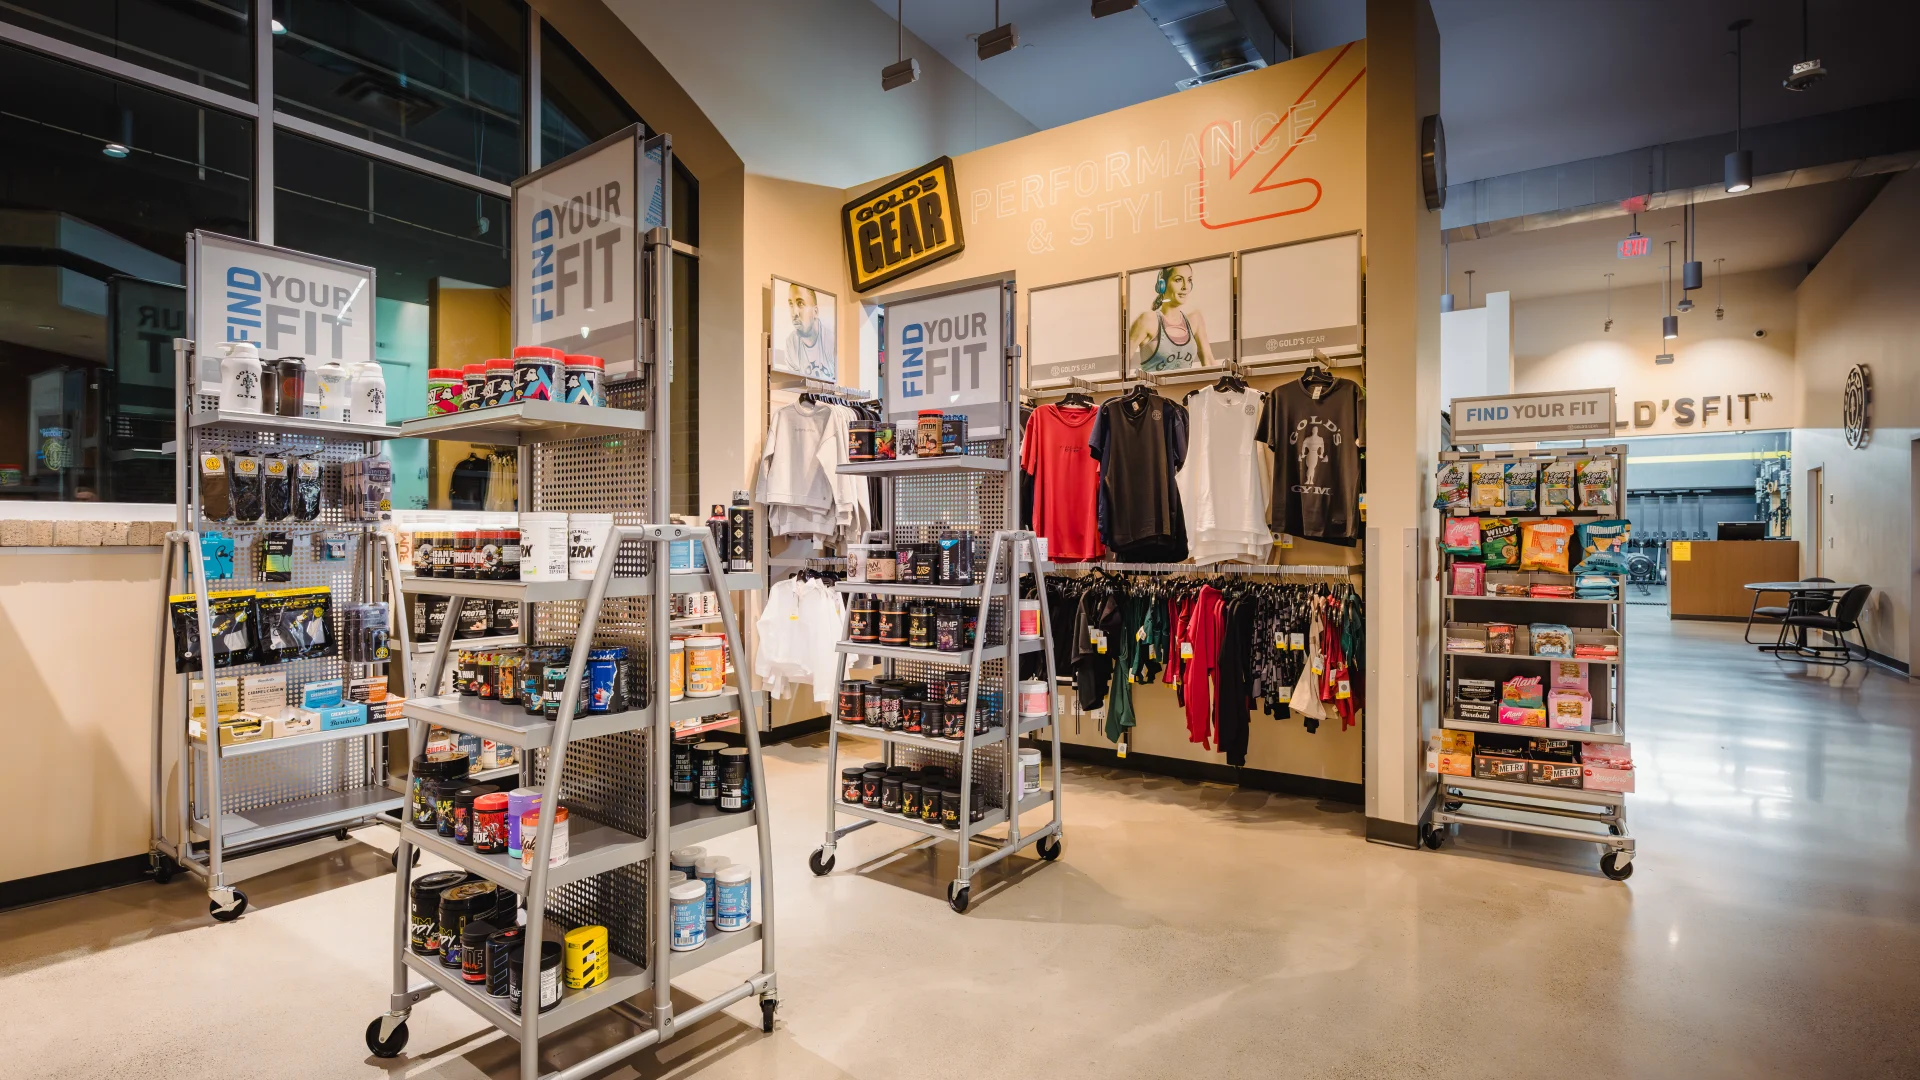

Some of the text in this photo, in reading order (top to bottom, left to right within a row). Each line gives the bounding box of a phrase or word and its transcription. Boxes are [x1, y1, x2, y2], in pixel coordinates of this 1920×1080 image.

[971, 100, 1317, 224] PERFORMANCE
[553, 180, 621, 239] YOUR
[856, 175, 938, 221] GOLD'S
[1027, 180, 1210, 254] & STYLE
[858, 191, 946, 273] GEAR
[1623, 237, 1649, 257] EXIT
[532, 208, 554, 324] FIND
[556, 227, 621, 317] FIT
[226, 266, 262, 348] FIND
[262, 272, 352, 312] YOUR
[265, 303, 352, 359] FIT
[924, 312, 987, 345] YOUR
[1279, 335, 1326, 348] GOLD'S GEAR
[902, 323, 923, 398] FIND
[926, 342, 987, 394] FIT
[1060, 362, 1096, 375] GOLD'S GEAR
[1289, 415, 1343, 446] GOLD'S
[1467, 401, 1598, 422] FIND YOUR FIT
[1290, 484, 1332, 496] GYM
[1486, 524, 1515, 537] WILDE
[942, 550, 950, 580] KARBOLYN
[1460, 711, 1490, 719] Barebells
